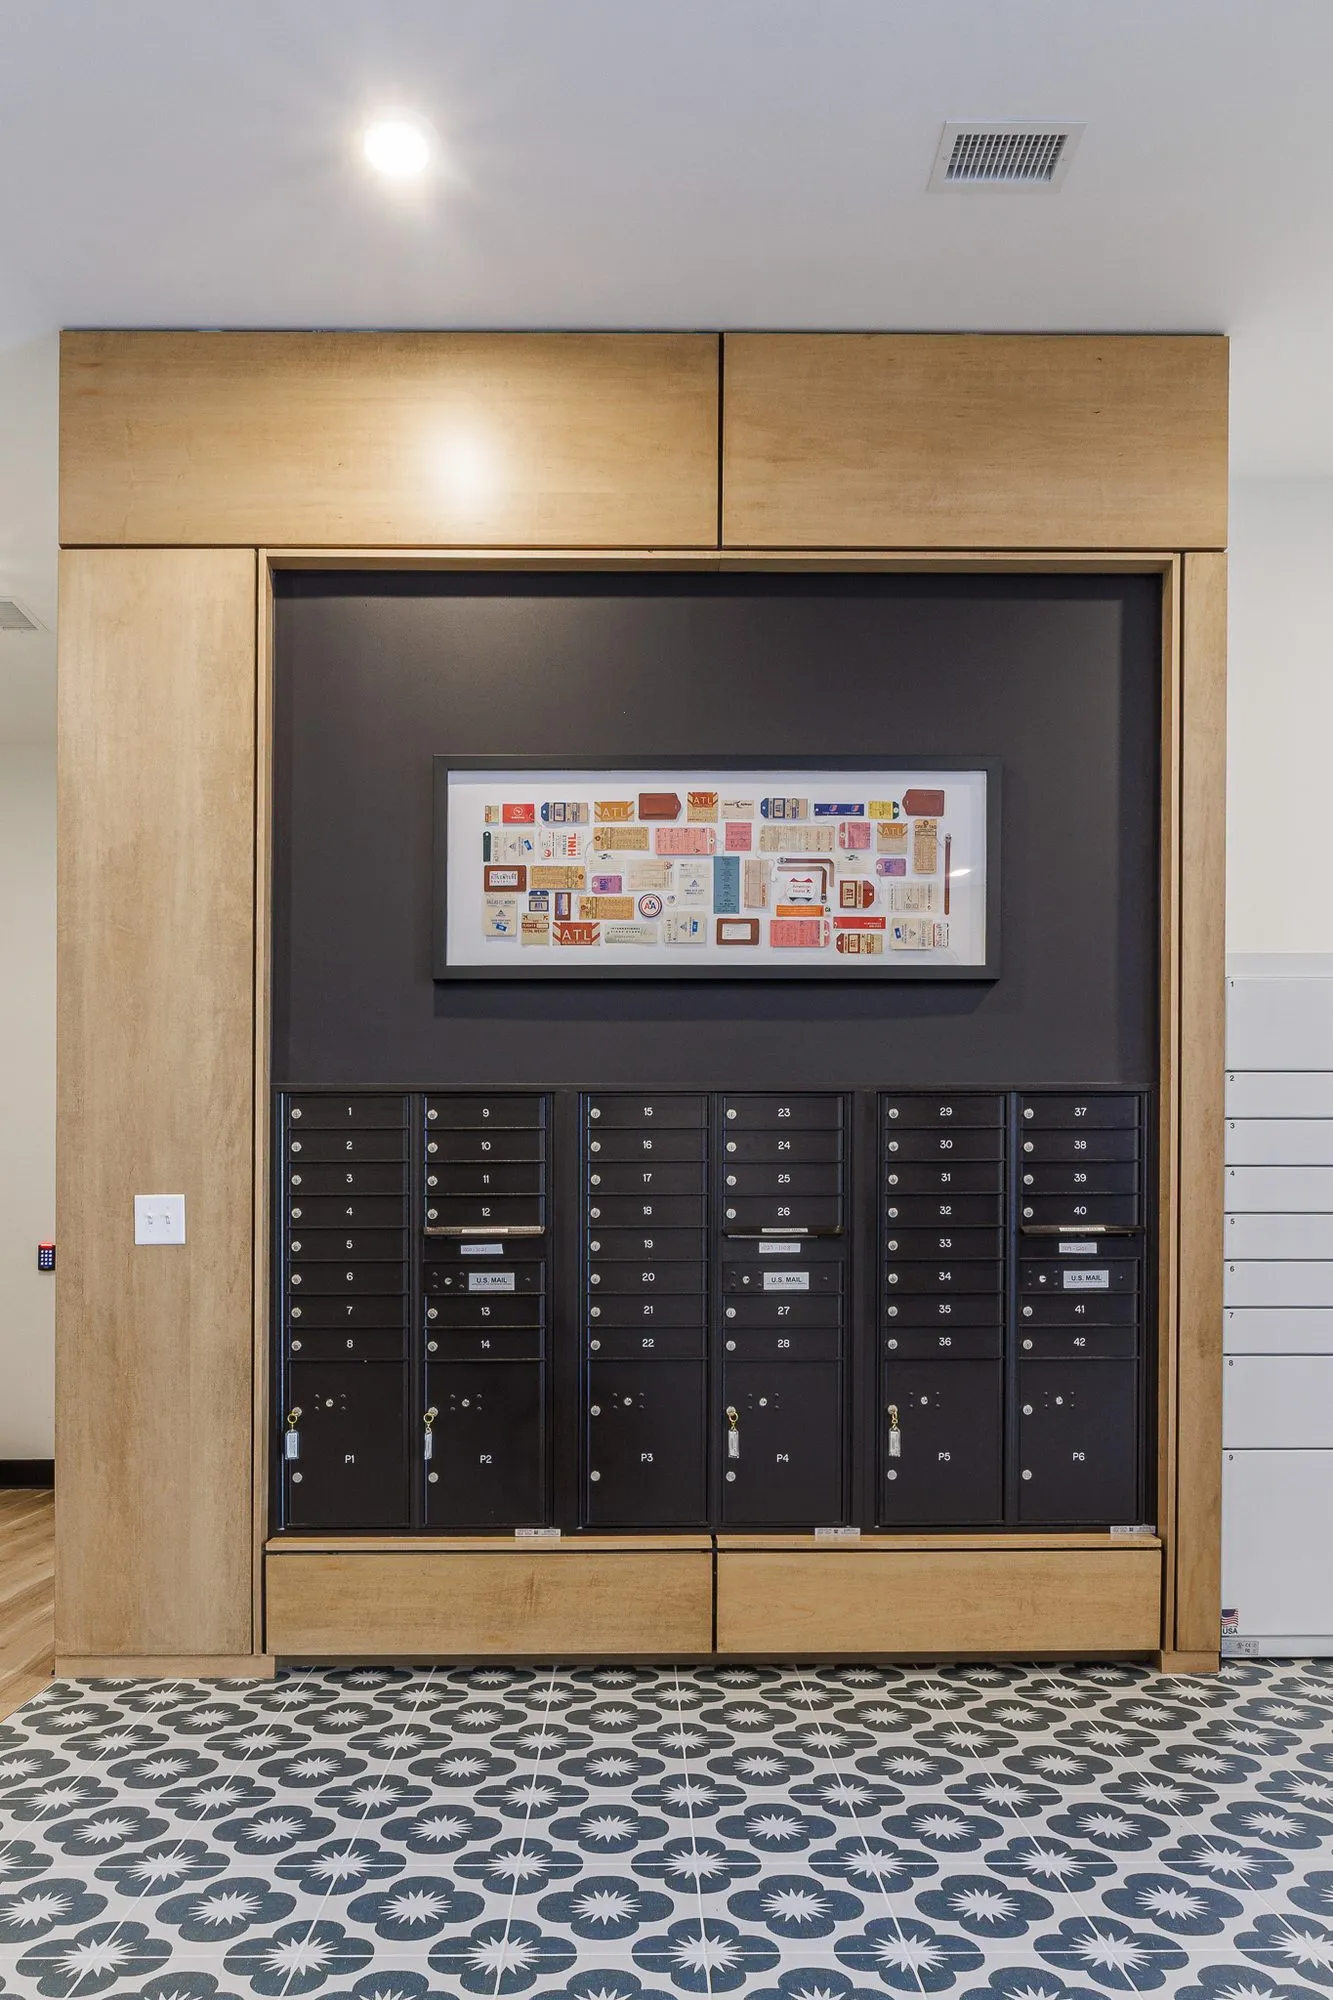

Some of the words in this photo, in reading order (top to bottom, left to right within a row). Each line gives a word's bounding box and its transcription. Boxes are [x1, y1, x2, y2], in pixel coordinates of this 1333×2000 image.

[693, 796, 713, 805] ATL
[601, 807, 627, 817] ATL
[883, 827, 903, 837] ATL
[567, 832, 577, 857] HNL
[562, 929, 591, 941] ATL
[1230, 980, 1235, 988] 1
[348, 1107, 352, 1116] 1
[482, 1108, 490, 1118] 9
[643, 1107, 653, 1116] 15
[777, 1107, 791, 1117] 23
[939, 1106, 953, 1116] 29
[1074, 1107, 1087, 1117] 37
[346, 1140, 353, 1150] 2
[481, 1141, 491, 1151] 10
[642, 1140, 653, 1149] 16
[778, 1140, 791, 1150] 24
[939, 1139, 953, 1149] 30
[1074, 1140, 1087, 1150] 38
[346, 1173, 353, 1183] 3
[483, 1174, 490, 1184] 11
[643, 1173, 652, 1182] 17
[777, 1174, 791, 1184] 25
[940, 1172, 951, 1182] 31
[1073, 1173, 1087, 1183] 39
[346, 1207, 353, 1216] 4
[481, 1207, 491, 1217] 12
[642, 1205, 653, 1216] 18
[777, 1206, 791, 1217] 26
[939, 1205, 952, 1215] 32
[1073, 1206, 1087, 1215] 40
[346, 1239, 353, 1249] 5
[643, 1239, 654, 1249] 19
[939, 1238, 952, 1248] 33
[1229, 1265, 1236, 1273] 6
[346, 1271, 354, 1281] 6
[491, 1276, 507, 1284] MAIL
[642, 1272, 655, 1282] 20
[938, 1271, 952, 1281] 34
[1070, 1274, 1084, 1282] U.S.
[346, 1306, 353, 1315] 7
[481, 1306, 491, 1316] 13
[643, 1305, 654, 1315] 21
[777, 1306, 790, 1315] 27
[938, 1304, 952, 1314] 35
[1074, 1304, 1085, 1314] 41
[346, 1339, 354, 1349] 8
[481, 1340, 491, 1349] 14
[642, 1338, 655, 1348] 22
[777, 1339, 790, 1348] 28
[938, 1337, 952, 1347] 36
[1073, 1337, 1086, 1347] 42
[1228, 1359, 1235, 1367] 8
[345, 1454, 355, 1464] P1
[479, 1454, 492, 1464] P2
[640, 1453, 654, 1462] P3
[776, 1453, 790, 1463] P4
[938, 1452, 951, 1461] P5
[1072, 1452, 1085, 1461] P6
[1221, 1627, 1238, 1636] USA
